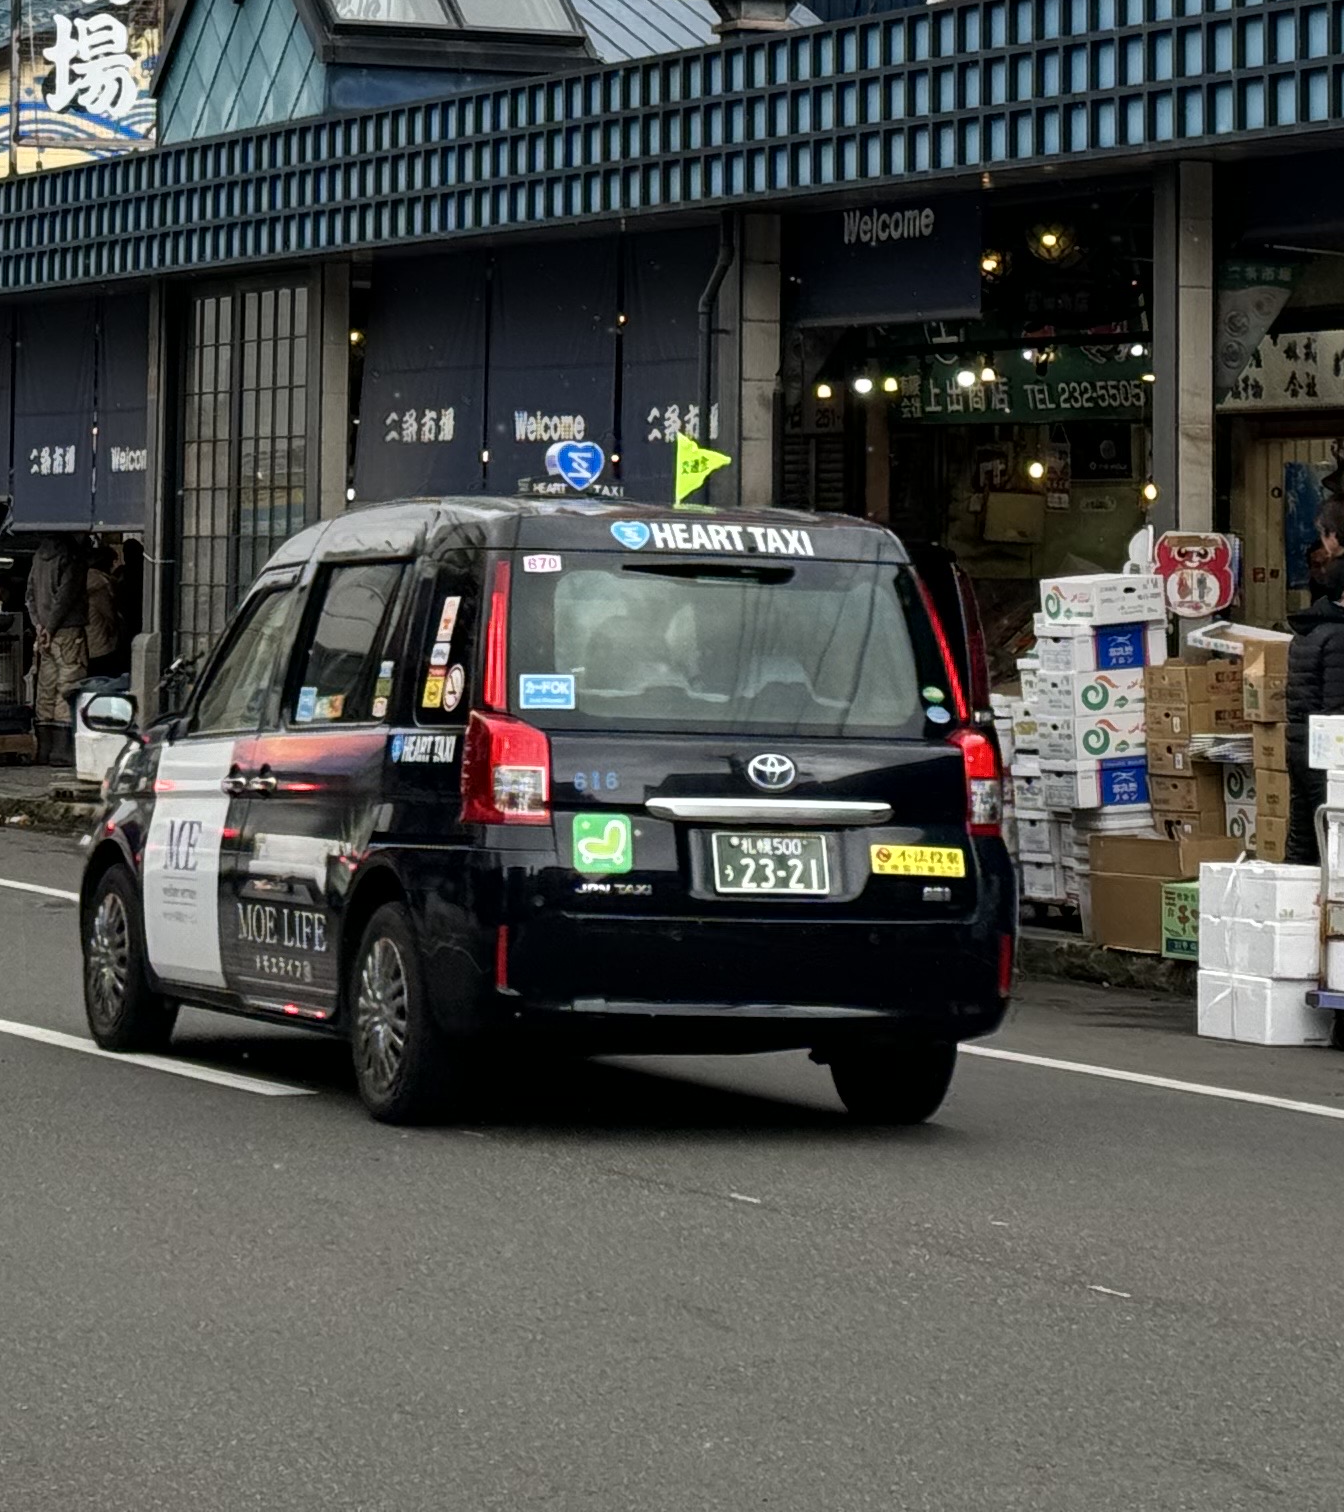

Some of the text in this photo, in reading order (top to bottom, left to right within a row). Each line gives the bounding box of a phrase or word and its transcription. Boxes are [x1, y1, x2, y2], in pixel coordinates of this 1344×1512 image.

[844, 207, 935, 245] Welcome
[1023, 384, 1056, 410] TEL
[1058, 381, 1146, 409] 232-5505
[384, 405, 455, 443] 二条市場
[513, 410, 586, 442] Welcome
[593, 484, 625, 497] TAXI
[650, 522, 815, 557] HEART TAXI
[525, 680, 570, 695] カードOK
[433, 735, 457, 763] TAXI
[739, 856, 819, 890] 23-21
[613, 883, 653, 896] TAXI
[237, 902, 328, 952] MOE LIFE
